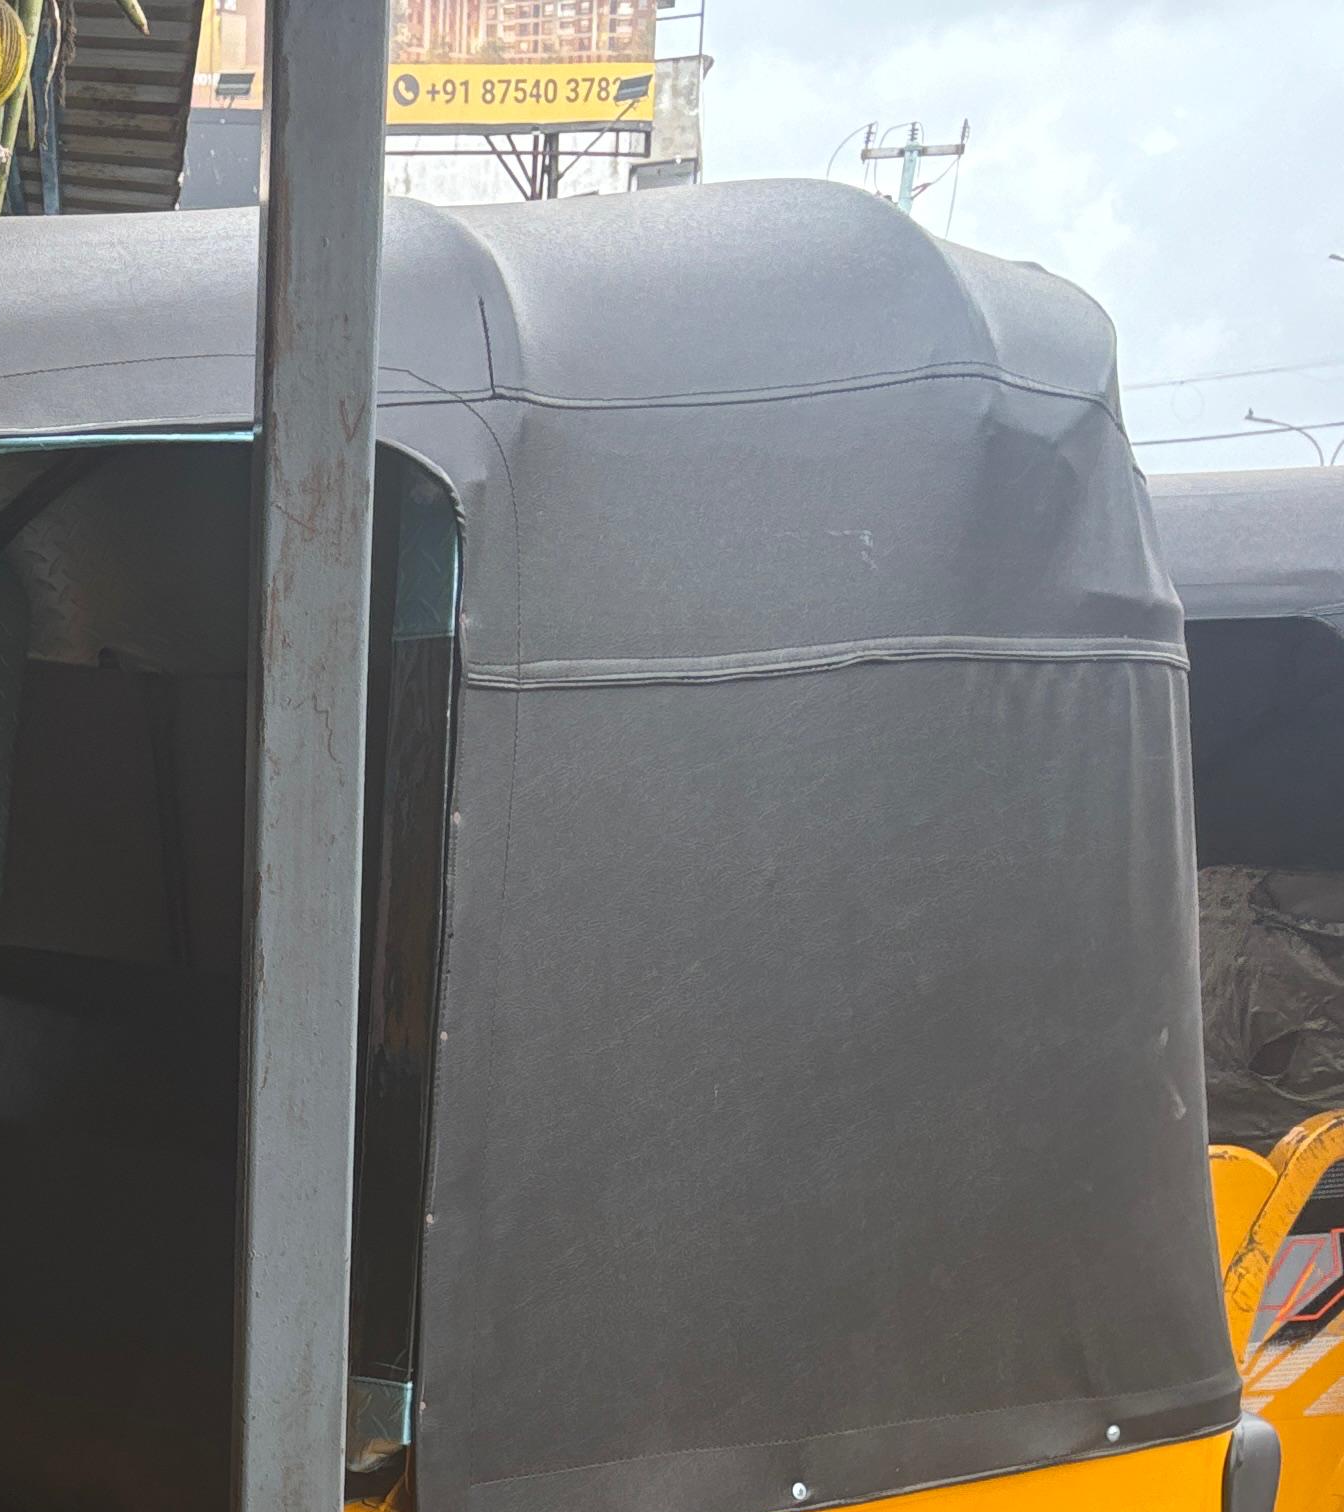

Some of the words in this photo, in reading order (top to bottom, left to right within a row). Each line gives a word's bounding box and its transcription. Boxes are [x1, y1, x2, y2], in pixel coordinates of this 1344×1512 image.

[426, 78, 470, 104] +91
[481, 79, 558, 104] 87540
[565, 76, 623, 104] 378
